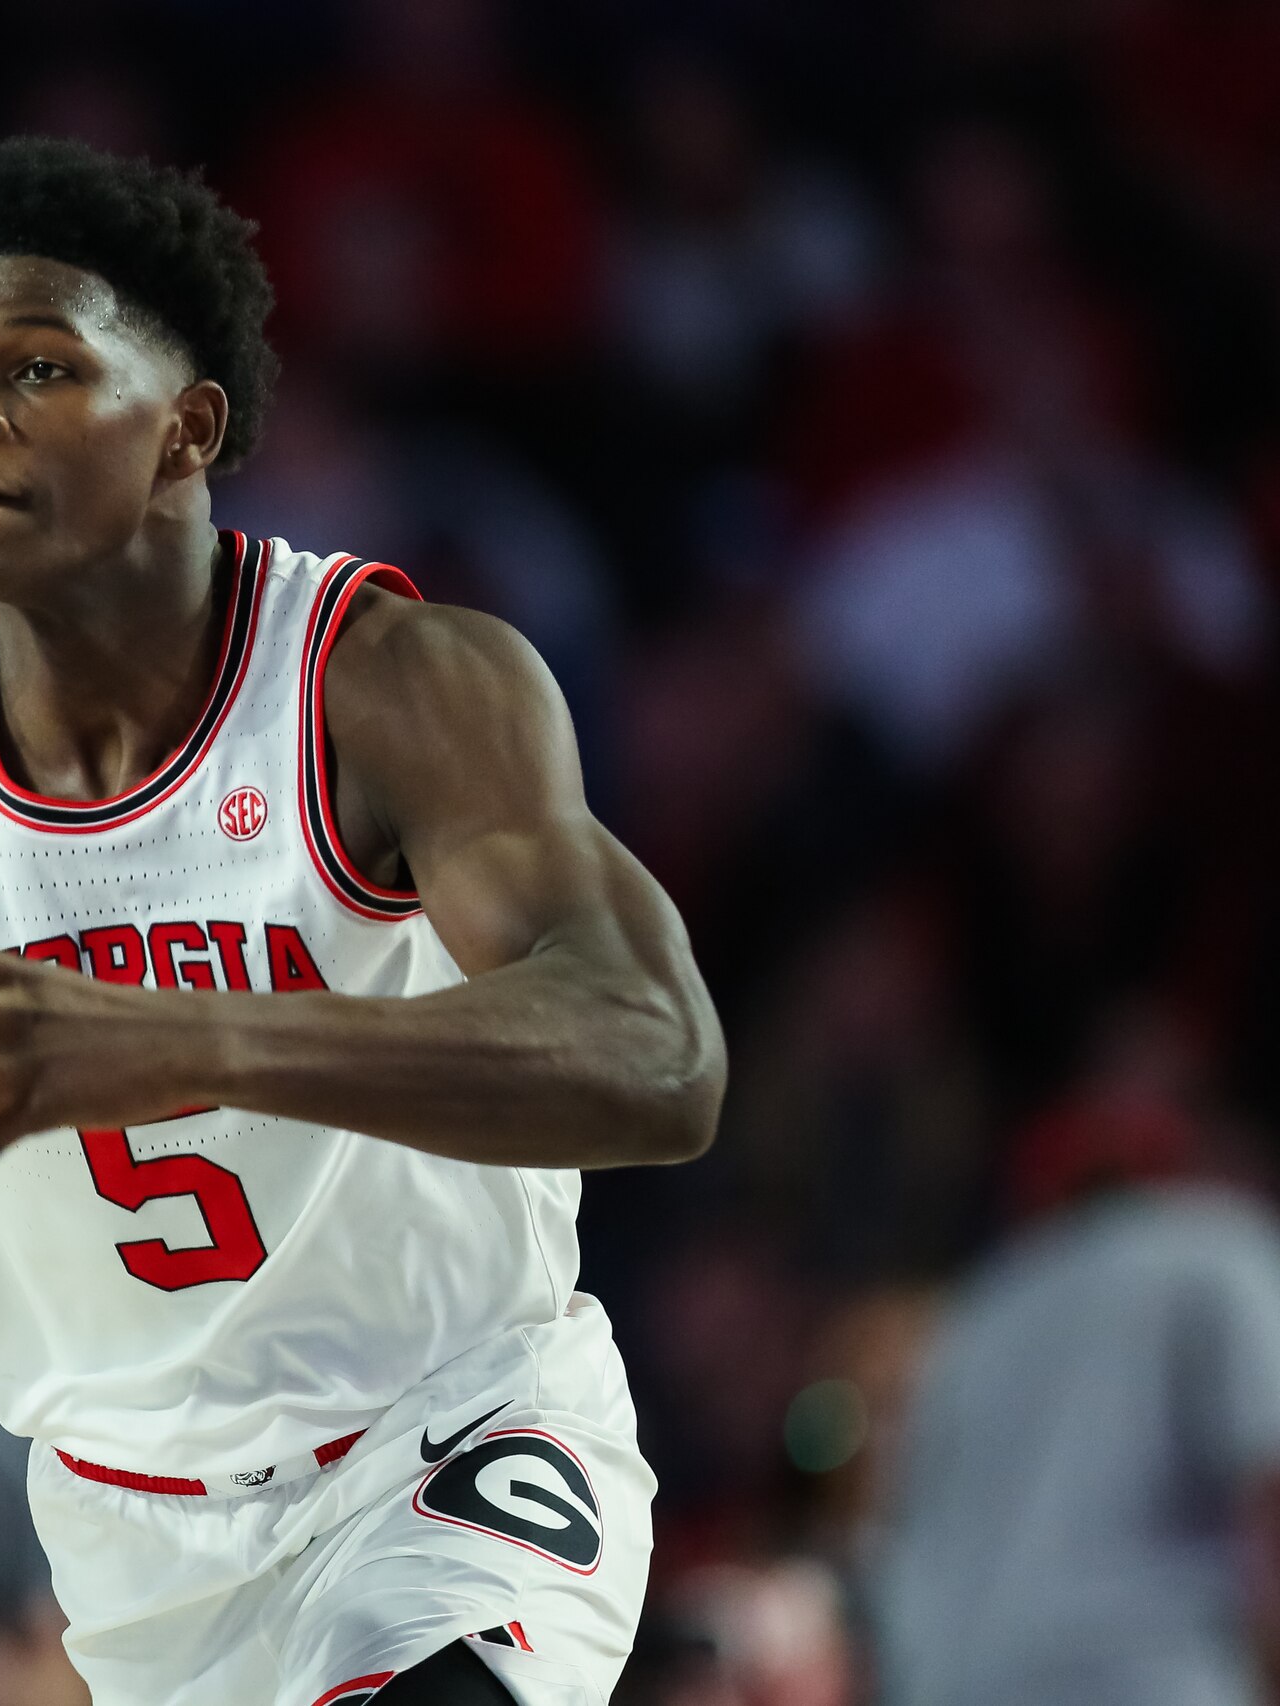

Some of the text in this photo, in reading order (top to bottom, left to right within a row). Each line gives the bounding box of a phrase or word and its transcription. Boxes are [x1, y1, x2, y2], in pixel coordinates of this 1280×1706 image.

[222, 791, 262, 836] SEC
[76, 1105, 268, 1292] 5
[420, 1435, 601, 1567] G
